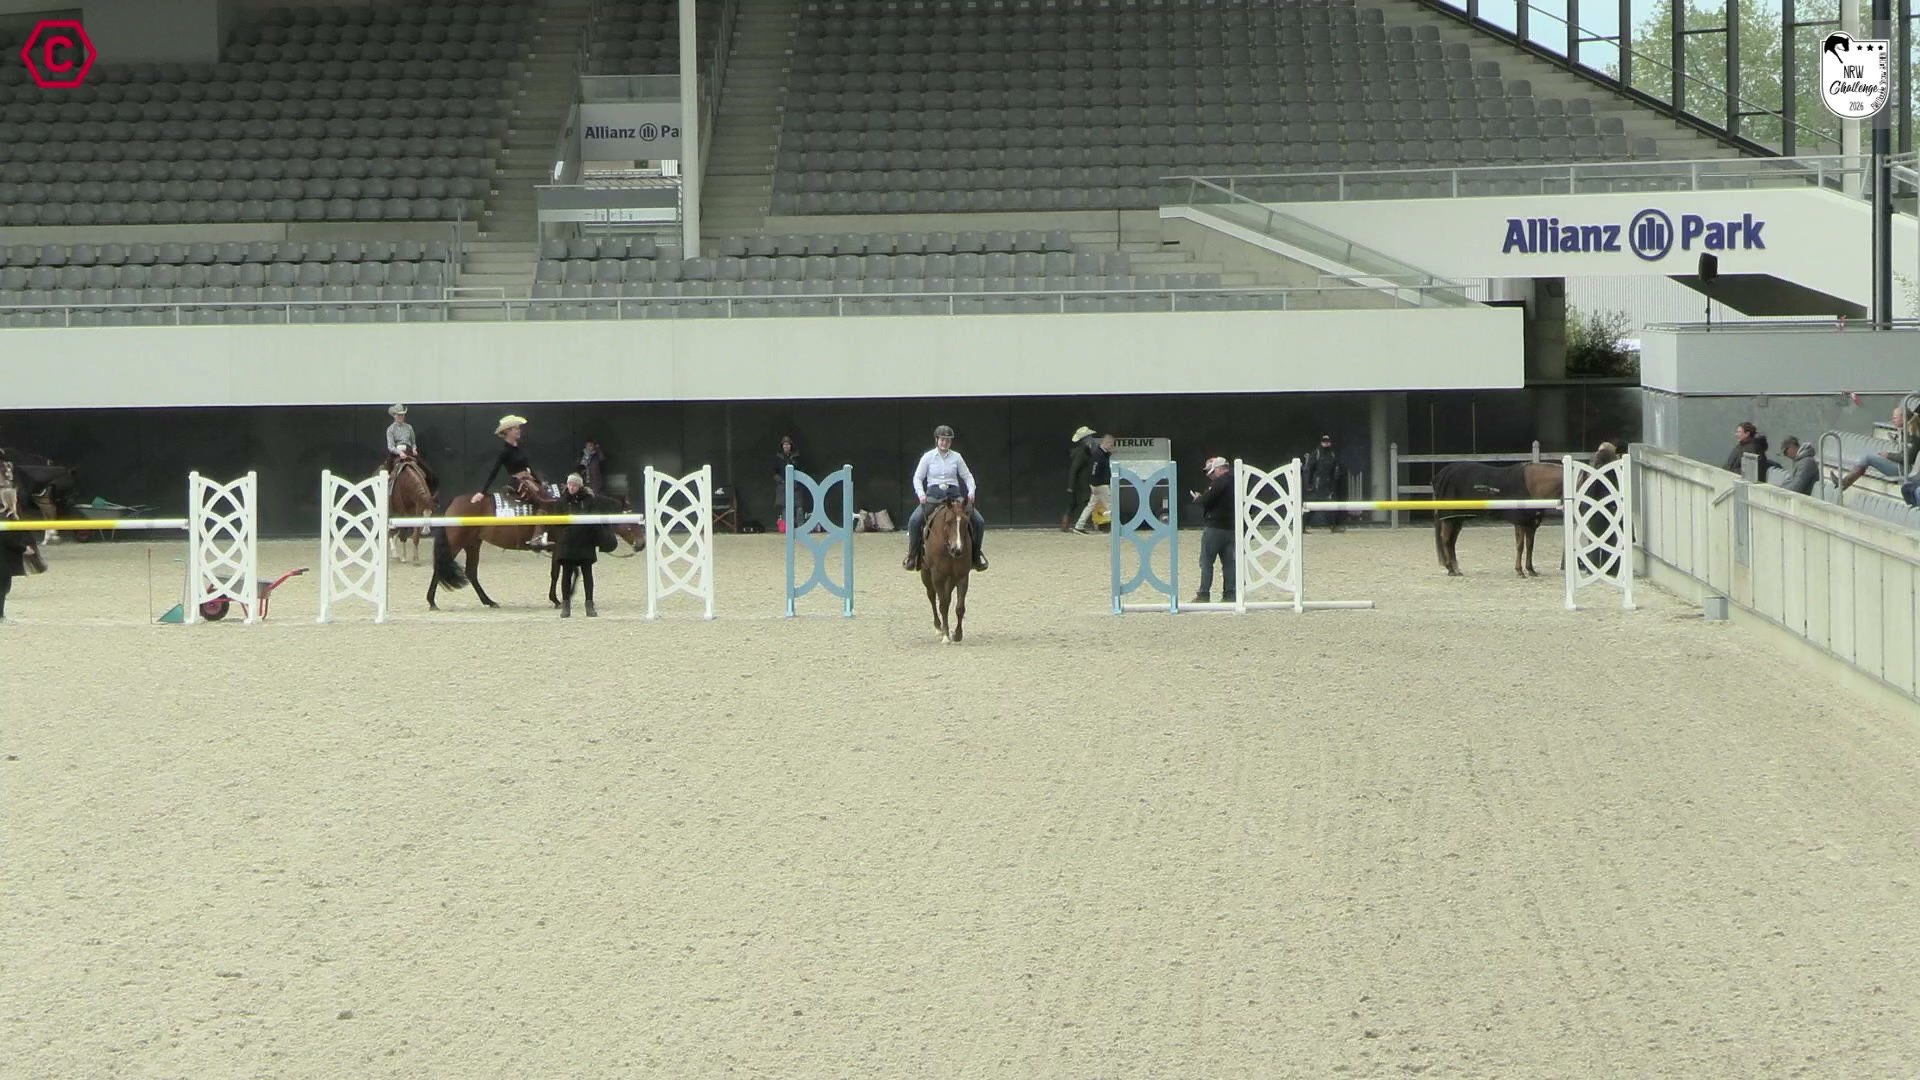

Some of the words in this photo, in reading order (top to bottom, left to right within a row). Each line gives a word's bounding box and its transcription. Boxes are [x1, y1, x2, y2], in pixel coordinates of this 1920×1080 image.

[584, 126, 636, 139] Allianz
[1502, 218, 1621, 253] Allianz
[1681, 213, 1766, 250] Park
